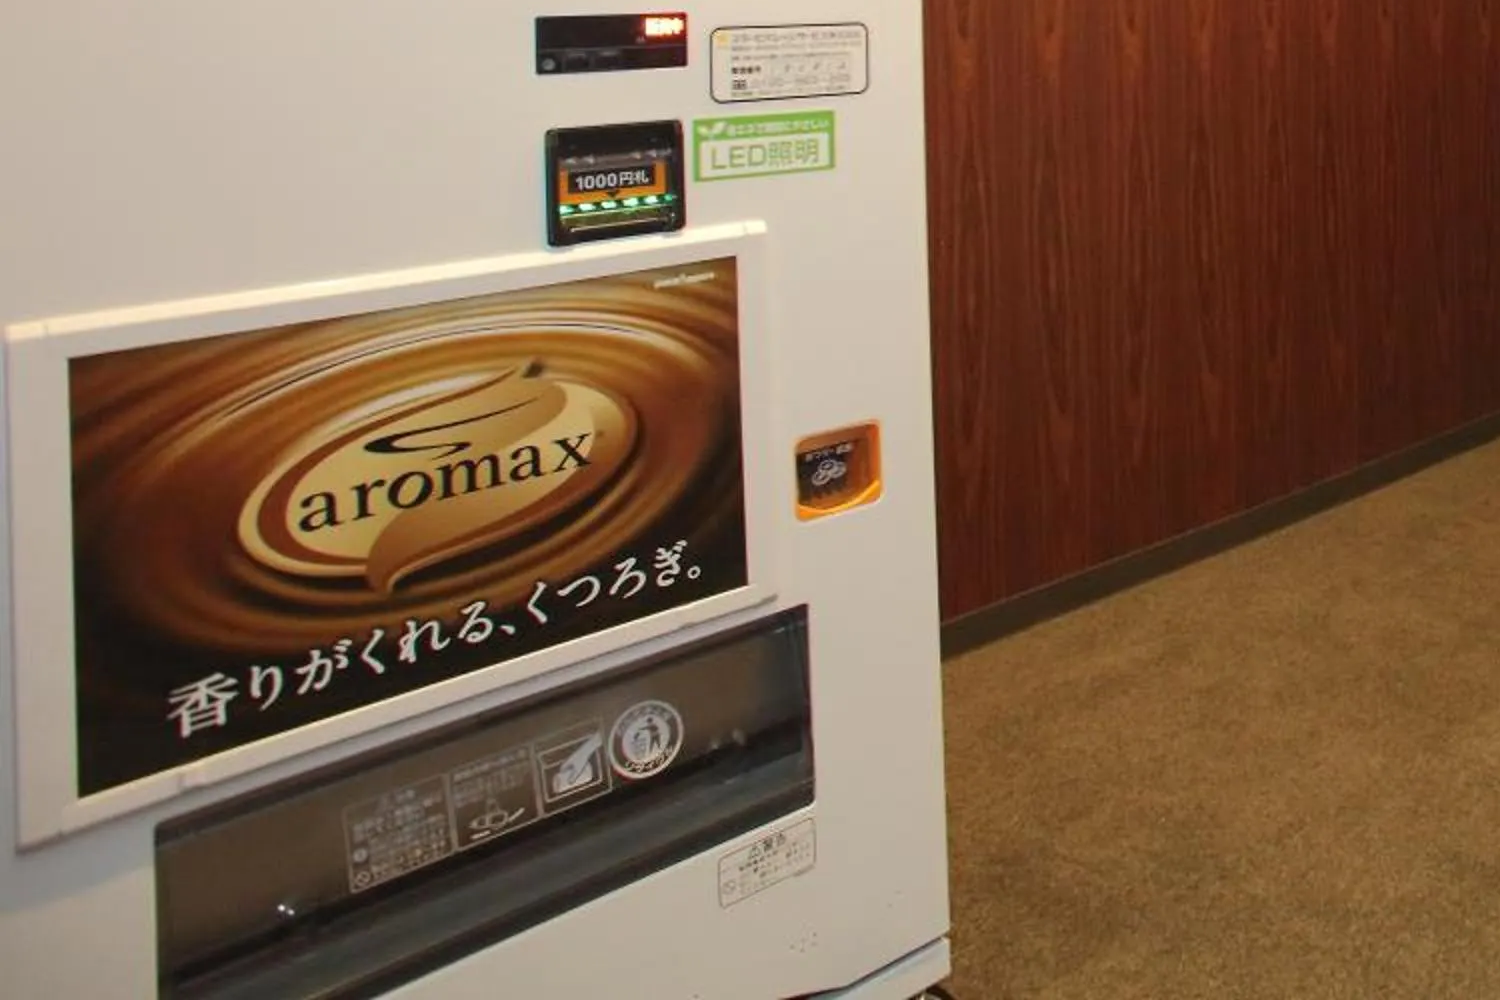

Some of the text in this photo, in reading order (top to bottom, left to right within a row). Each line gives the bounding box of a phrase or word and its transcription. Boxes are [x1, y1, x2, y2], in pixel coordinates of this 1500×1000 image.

[575, 169, 650, 191] 1000円札
[710, 138, 819, 170] LED照明
[298, 431, 593, 534] aromax
[166, 539, 703, 738] 香りがくれる、くつろぎ。
